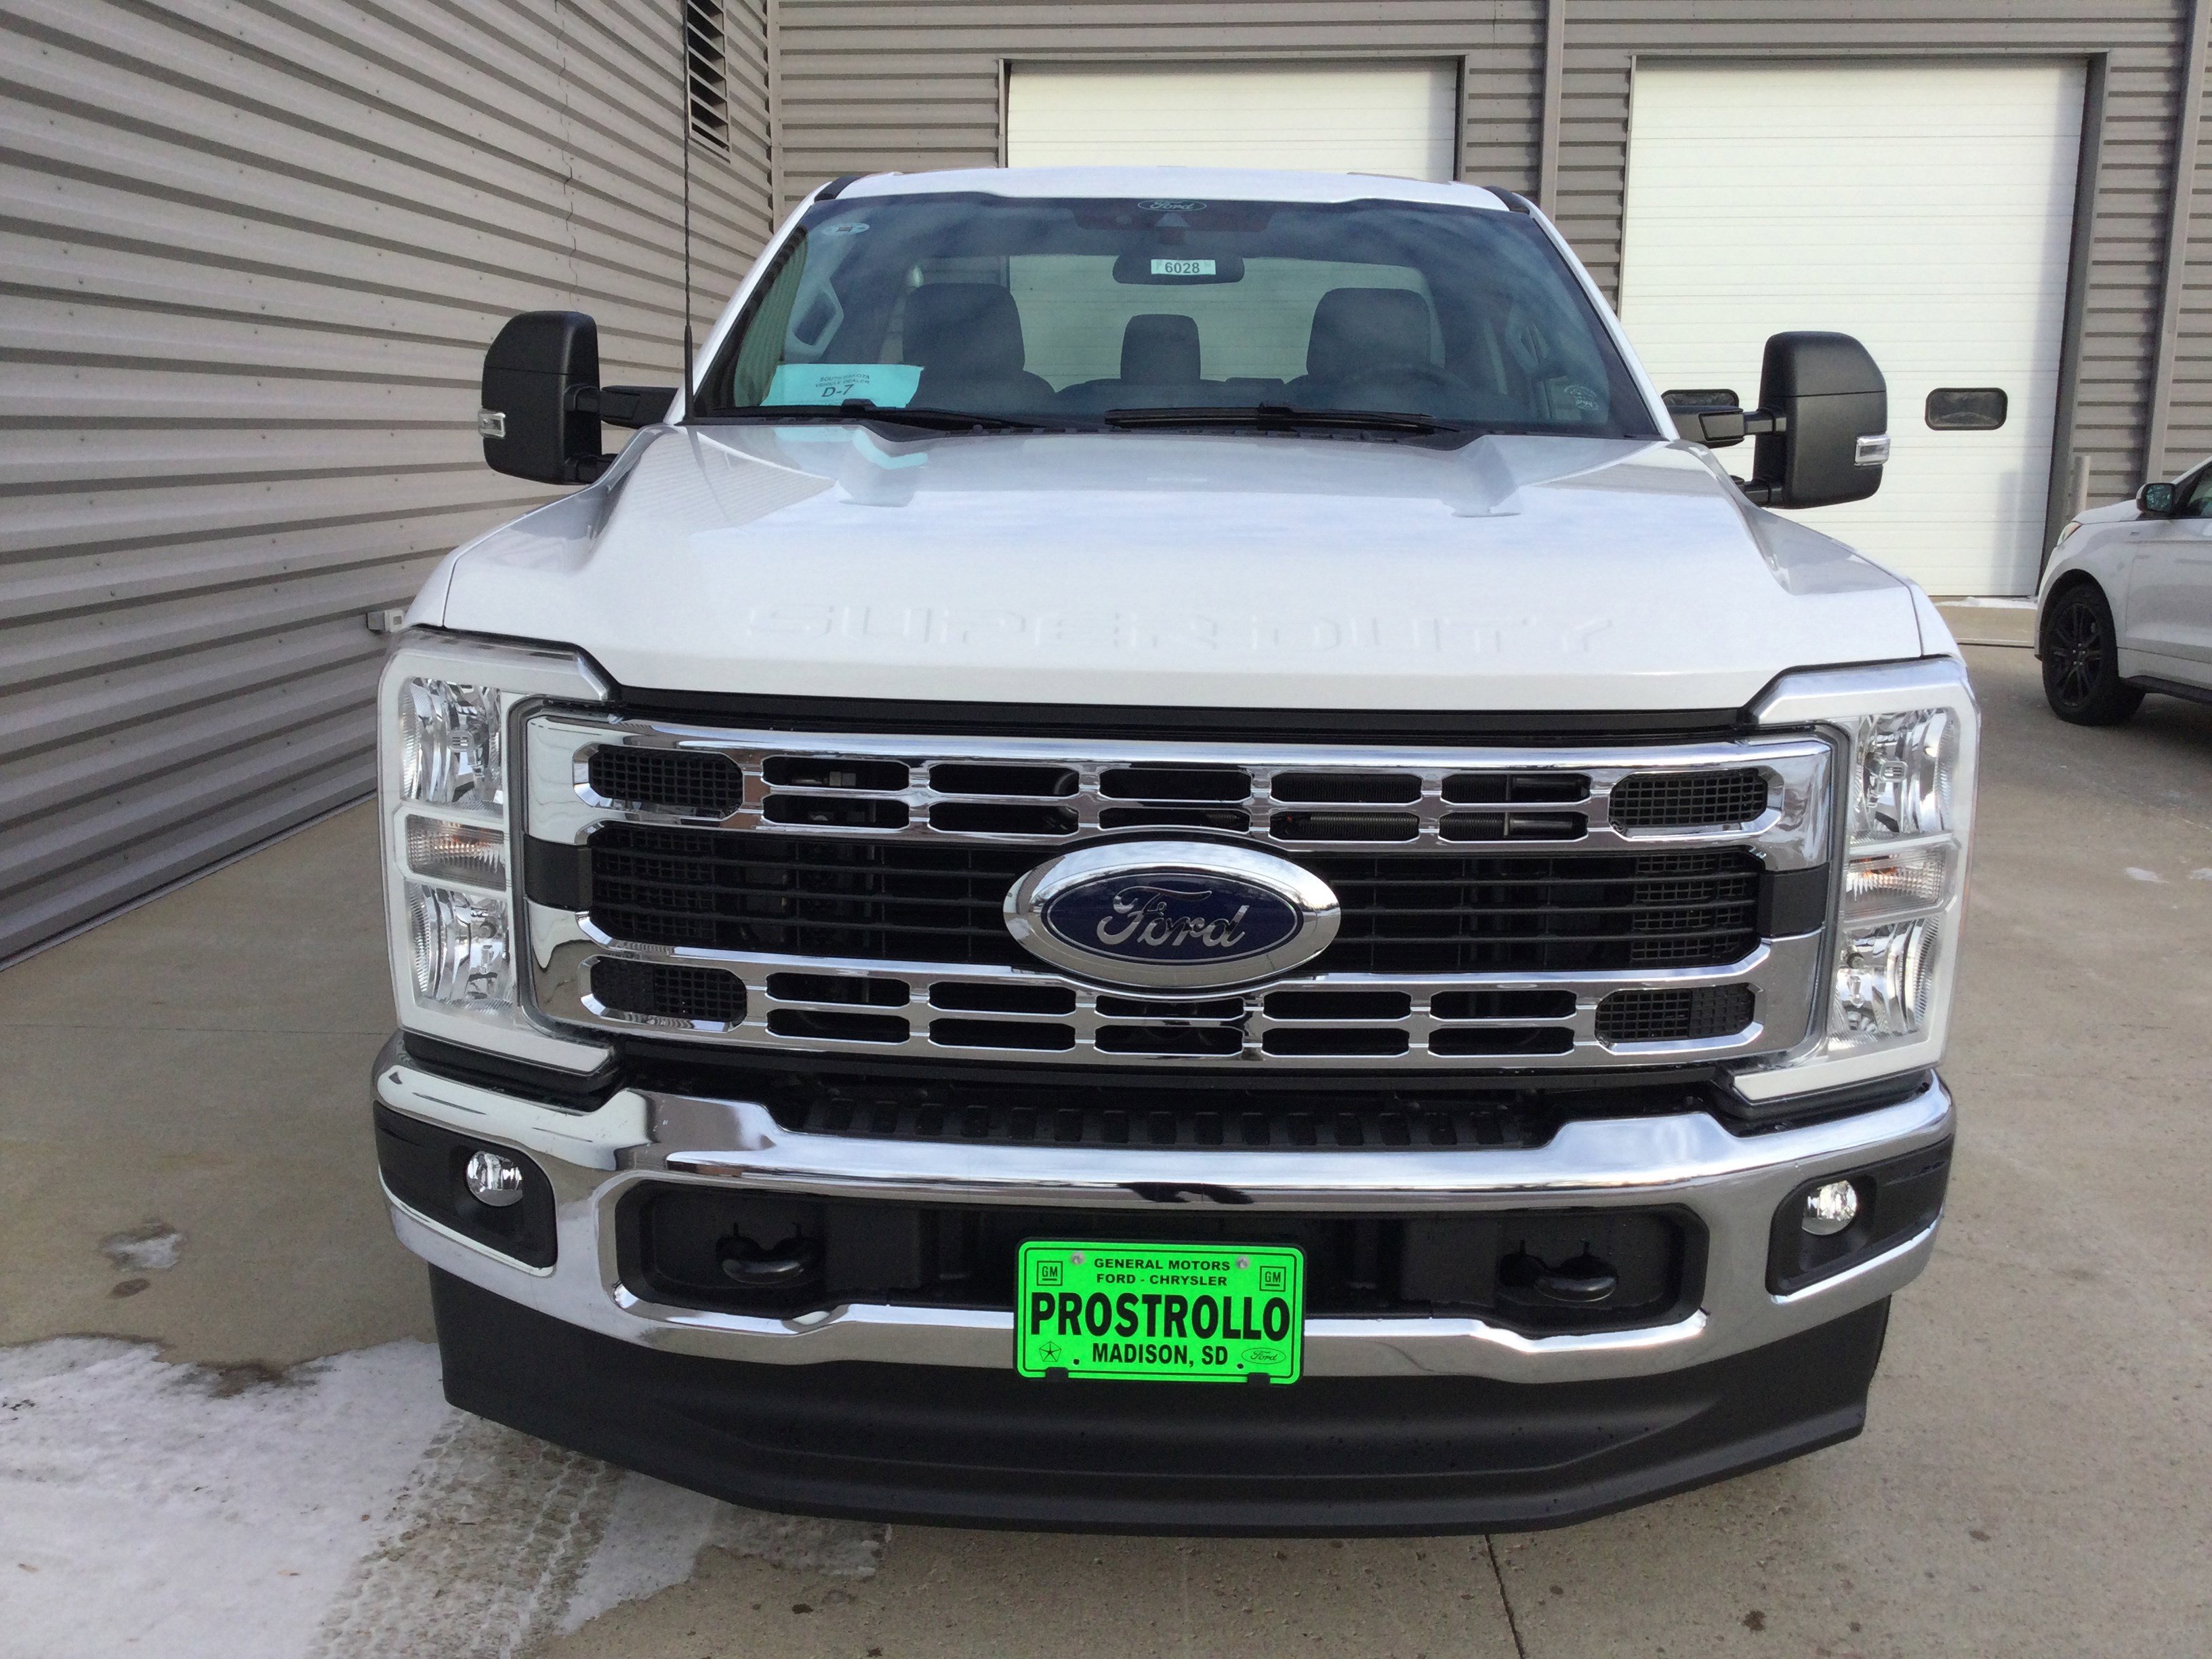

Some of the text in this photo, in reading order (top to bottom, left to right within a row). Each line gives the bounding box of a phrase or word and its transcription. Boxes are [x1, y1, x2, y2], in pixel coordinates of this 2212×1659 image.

[1149, 201, 1195, 209] Ford
[1165, 262, 1200, 274] 6028
[821, 384, 854, 397] D-7
[1097, 885, 1250, 947] Ford
[1094, 1258, 1231, 1271] GENERAL MOTORS
[1042, 1267, 1058, 1277] GM
[1265, 1272, 1282, 1283] GM
[1096, 1273, 1136, 1284] FORD
[1149, 1275, 1227, 1286] CHRYSLER
[1031, 1291, 1290, 1341] PROSTROLLO
[1092, 1343, 1228, 1368] MADISON, SD
[1250, 1349, 1278, 1361] Ford
